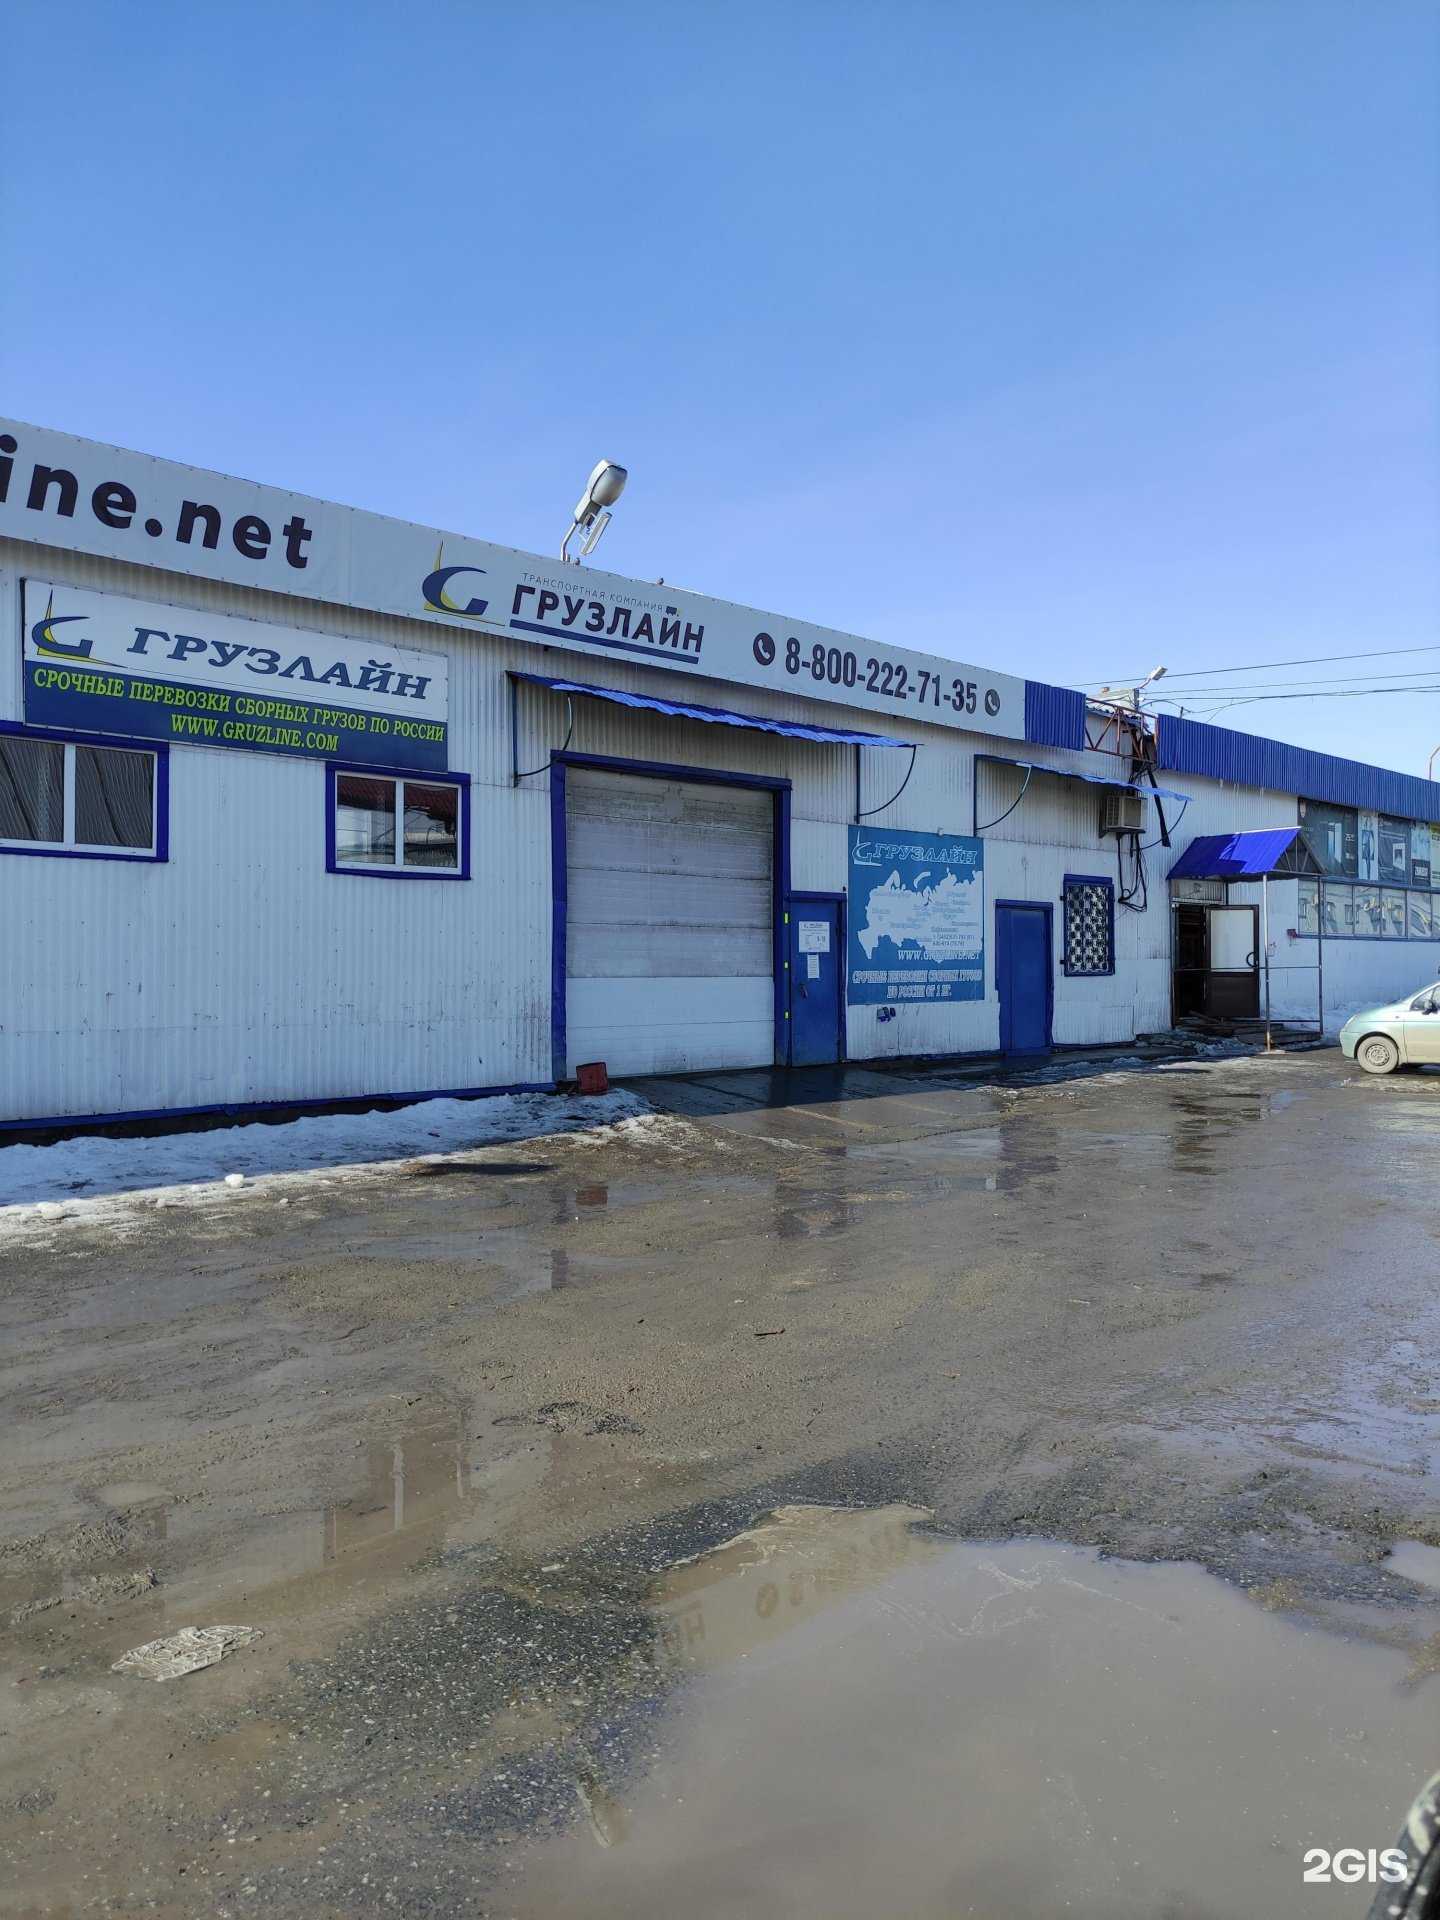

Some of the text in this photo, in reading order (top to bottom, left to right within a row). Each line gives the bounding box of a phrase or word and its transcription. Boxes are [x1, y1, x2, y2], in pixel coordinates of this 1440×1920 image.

[511, 584, 704, 653] ГРУЗЛАЙН
[522, 572, 663, 612] ТРАНСПОРТНАЯ КОМПАНИЯ
[126, 626, 432, 700] ГРУЗЛАЙН
[785, 637, 977, 714] 8-800-222-71-35
[34, 668, 445, 742] СРОЧНЫЕ ПЕРЕВОЗКИ СБОРНЫХ ГРУЗОВ ПО РОССИИ
[171, 713, 339, 752] WWW.GRUZLINE.COM
[872, 843, 978, 865] ГРУЗЛАЙН
